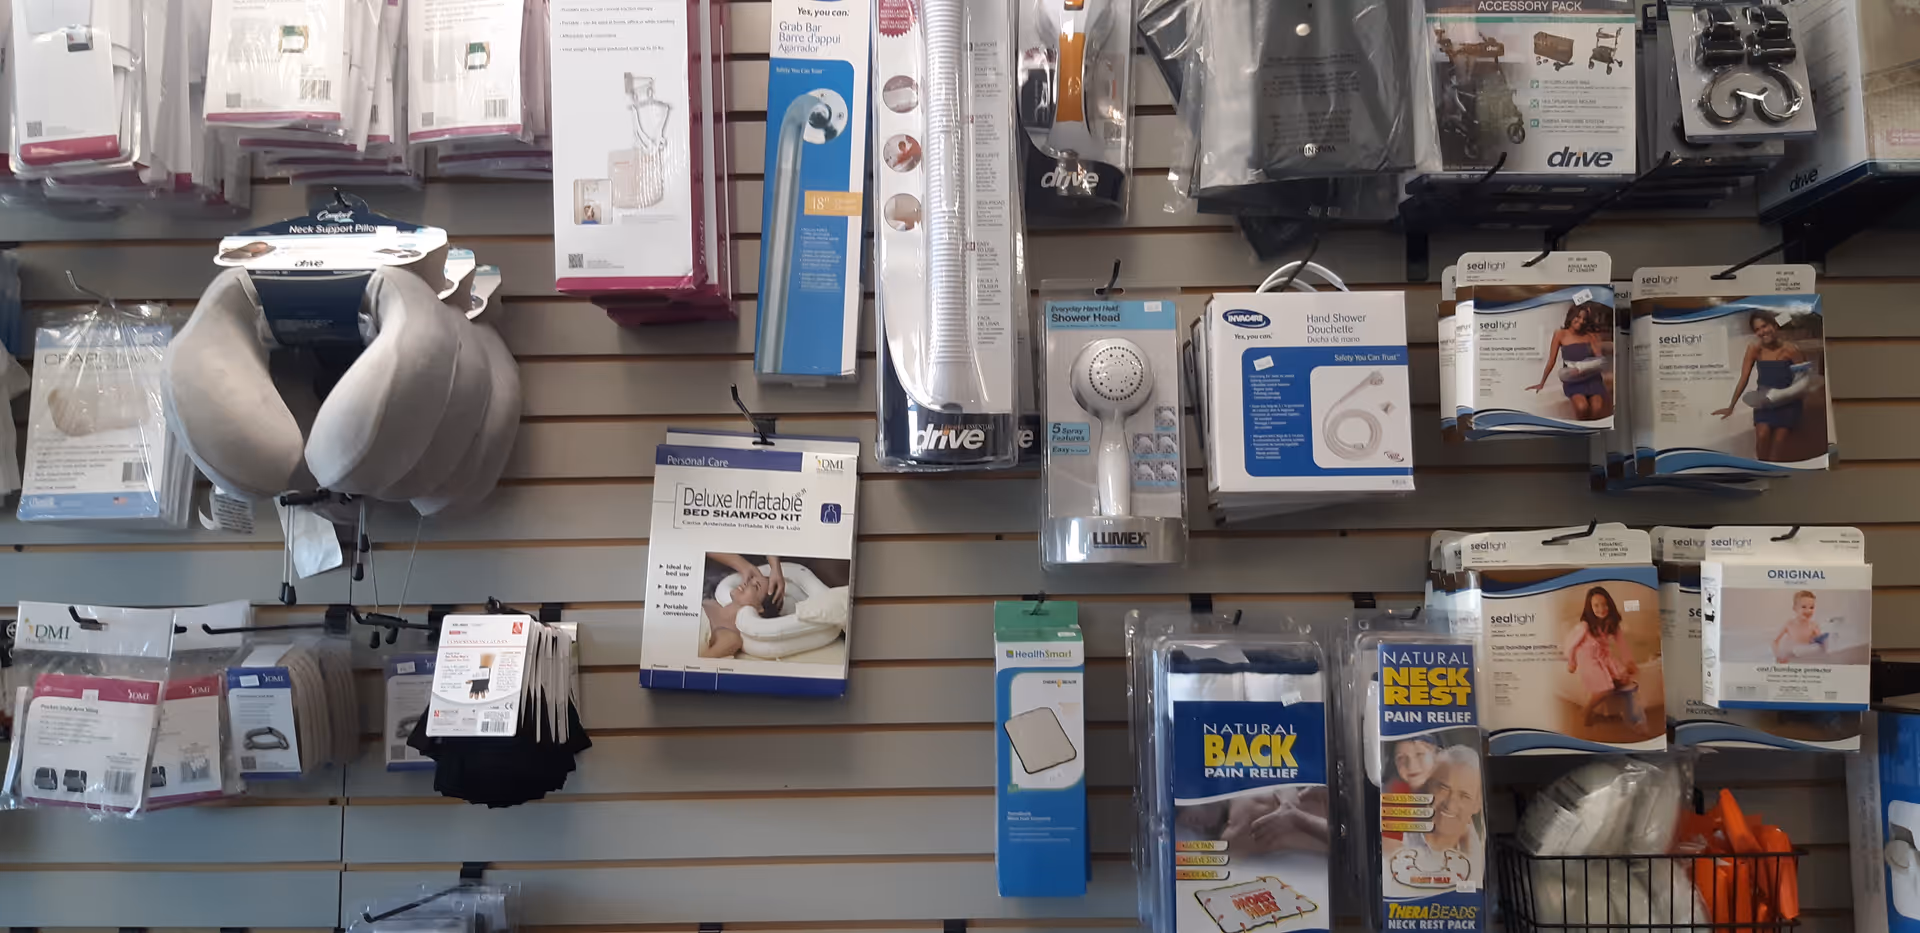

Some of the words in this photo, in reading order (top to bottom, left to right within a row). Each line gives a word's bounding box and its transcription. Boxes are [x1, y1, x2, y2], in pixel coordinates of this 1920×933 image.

[797, 6, 813, 17] Yes,
[814, 9, 831, 18] you
[1477, 0, 1548, 12] ACCESSORY
[1551, 0, 1583, 12] PACK
[779, 21, 803, 32] Grab
[805, 22, 822, 33] Bar
[778, 32, 805, 43] Barre
[807, 33, 841, 46] d'appui
[777, 43, 819, 54] Agarrador
[1546, 146, 1613, 168] drive
[1040, 167, 1100, 188] drive
[1789, 166, 1819, 193] drive
[316, 209, 355, 222] Comfort
[288, 224, 313, 234] Neck
[315, 224, 353, 235] Support
[1051, 305, 1082, 313] Everyday
[1051, 313, 1090, 322] Shower
[1093, 313, 1120, 322] Head
[1306, 313, 1331, 323] Hand
[1332, 313, 1367, 323] Shower
[1306, 324, 1354, 334] Douchette
[1306, 335, 1330, 343] Ducha
[1330, 335, 1340, 343] de
[1341, 335, 1361, 343] mano
[1334, 353, 1354, 363] Safety
[1354, 353, 1367, 362] You
[1367, 353, 1380, 361] Can
[1051, 422, 1061, 434] 5
[917, 423, 985, 450] drive
[1052, 446, 1070, 454] Easy
[667, 454, 706, 468] Personal
[707, 456, 729, 468] Care
[820, 458, 845, 471] DMI
[683, 487, 733, 509] Deluxe
[735, 489, 803, 513] Inflatable
[683, 508, 710, 517] BED
[712, 509, 777, 521] SHAMPOO
[780, 513, 802, 522] KIT
[1092, 531, 1147, 545] LUMEX
[665, 563, 682, 571] Ideal
[1767, 569, 1826, 581] ORIGINAL
[664, 583, 679, 591] Easy
[663, 602, 689, 611] Portable
[34, 623, 72, 641] DMI
[1015, 649, 1072, 659] HealthSmart
[1382, 651, 1469, 666] NATURAL
[1383, 666, 1471, 687] NECK
[1383, 685, 1472, 706] REST
[1384, 710, 1423, 724] PAIN
[1427, 711, 1472, 724] RELIEF
[1203, 723, 1298, 735] NATURAL
[1203, 734, 1299, 767] BACK
[1204, 767, 1244, 779] PAIN
[1249, 768, 1299, 779] RELIEF
[1388, 919, 1417, 930] NECK
[1419, 920, 1443, 930] REST
[1447, 920, 1476, 930] PACK
